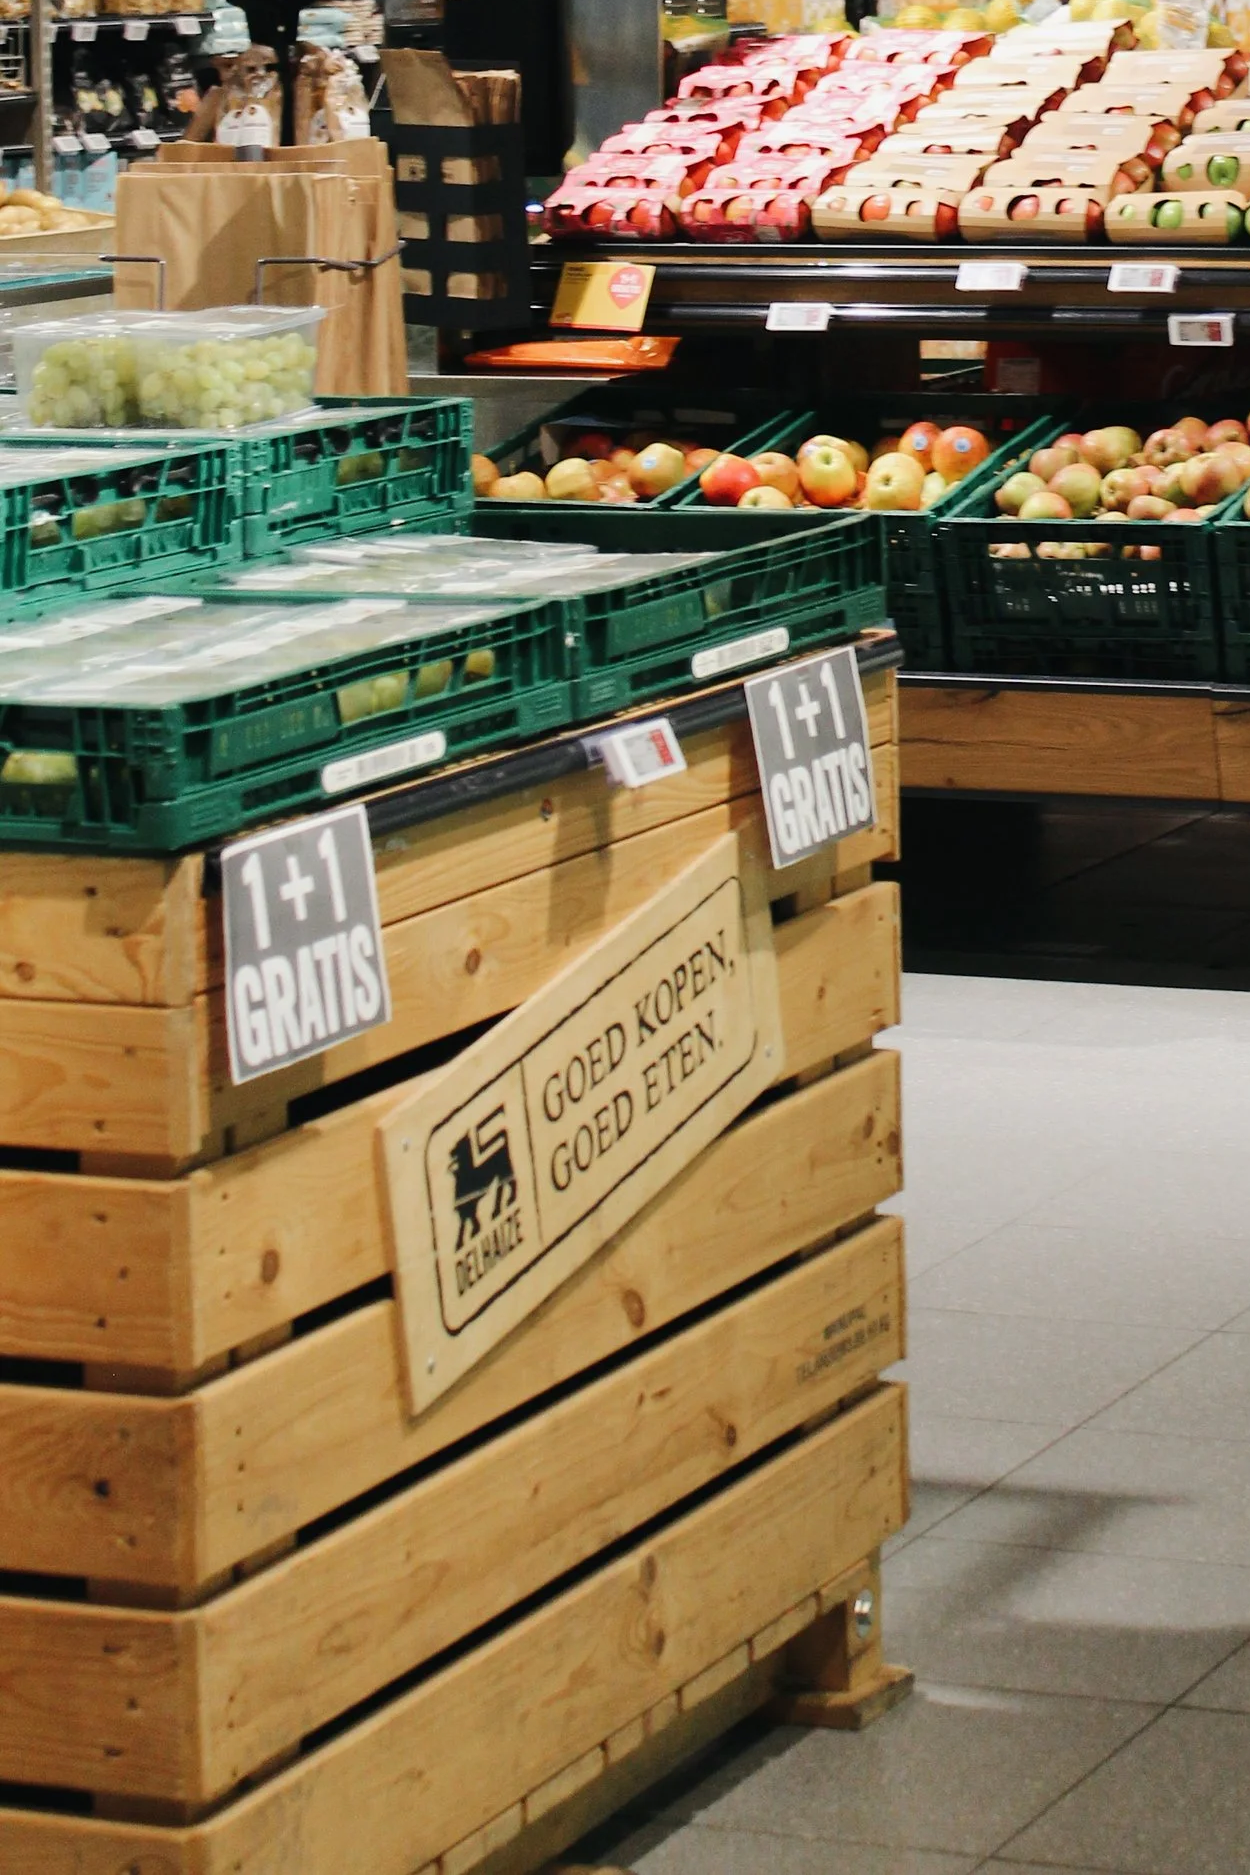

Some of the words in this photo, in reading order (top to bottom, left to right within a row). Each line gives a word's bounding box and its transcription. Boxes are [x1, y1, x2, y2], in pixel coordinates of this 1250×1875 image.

[767, 661, 846, 760] 1+1
[769, 741, 871, 855] GRATIS
[241, 827, 347, 951] 1+1
[233, 922, 381, 1067] GRATIS
[542, 1021, 628, 1123] GOED
[633, 929, 736, 1048] KOPEN,
[550, 1089, 634, 1192] GOED
[642, 1011, 724, 1114] ETEN.
[454, 1208, 525, 1298] DELHAIZE
